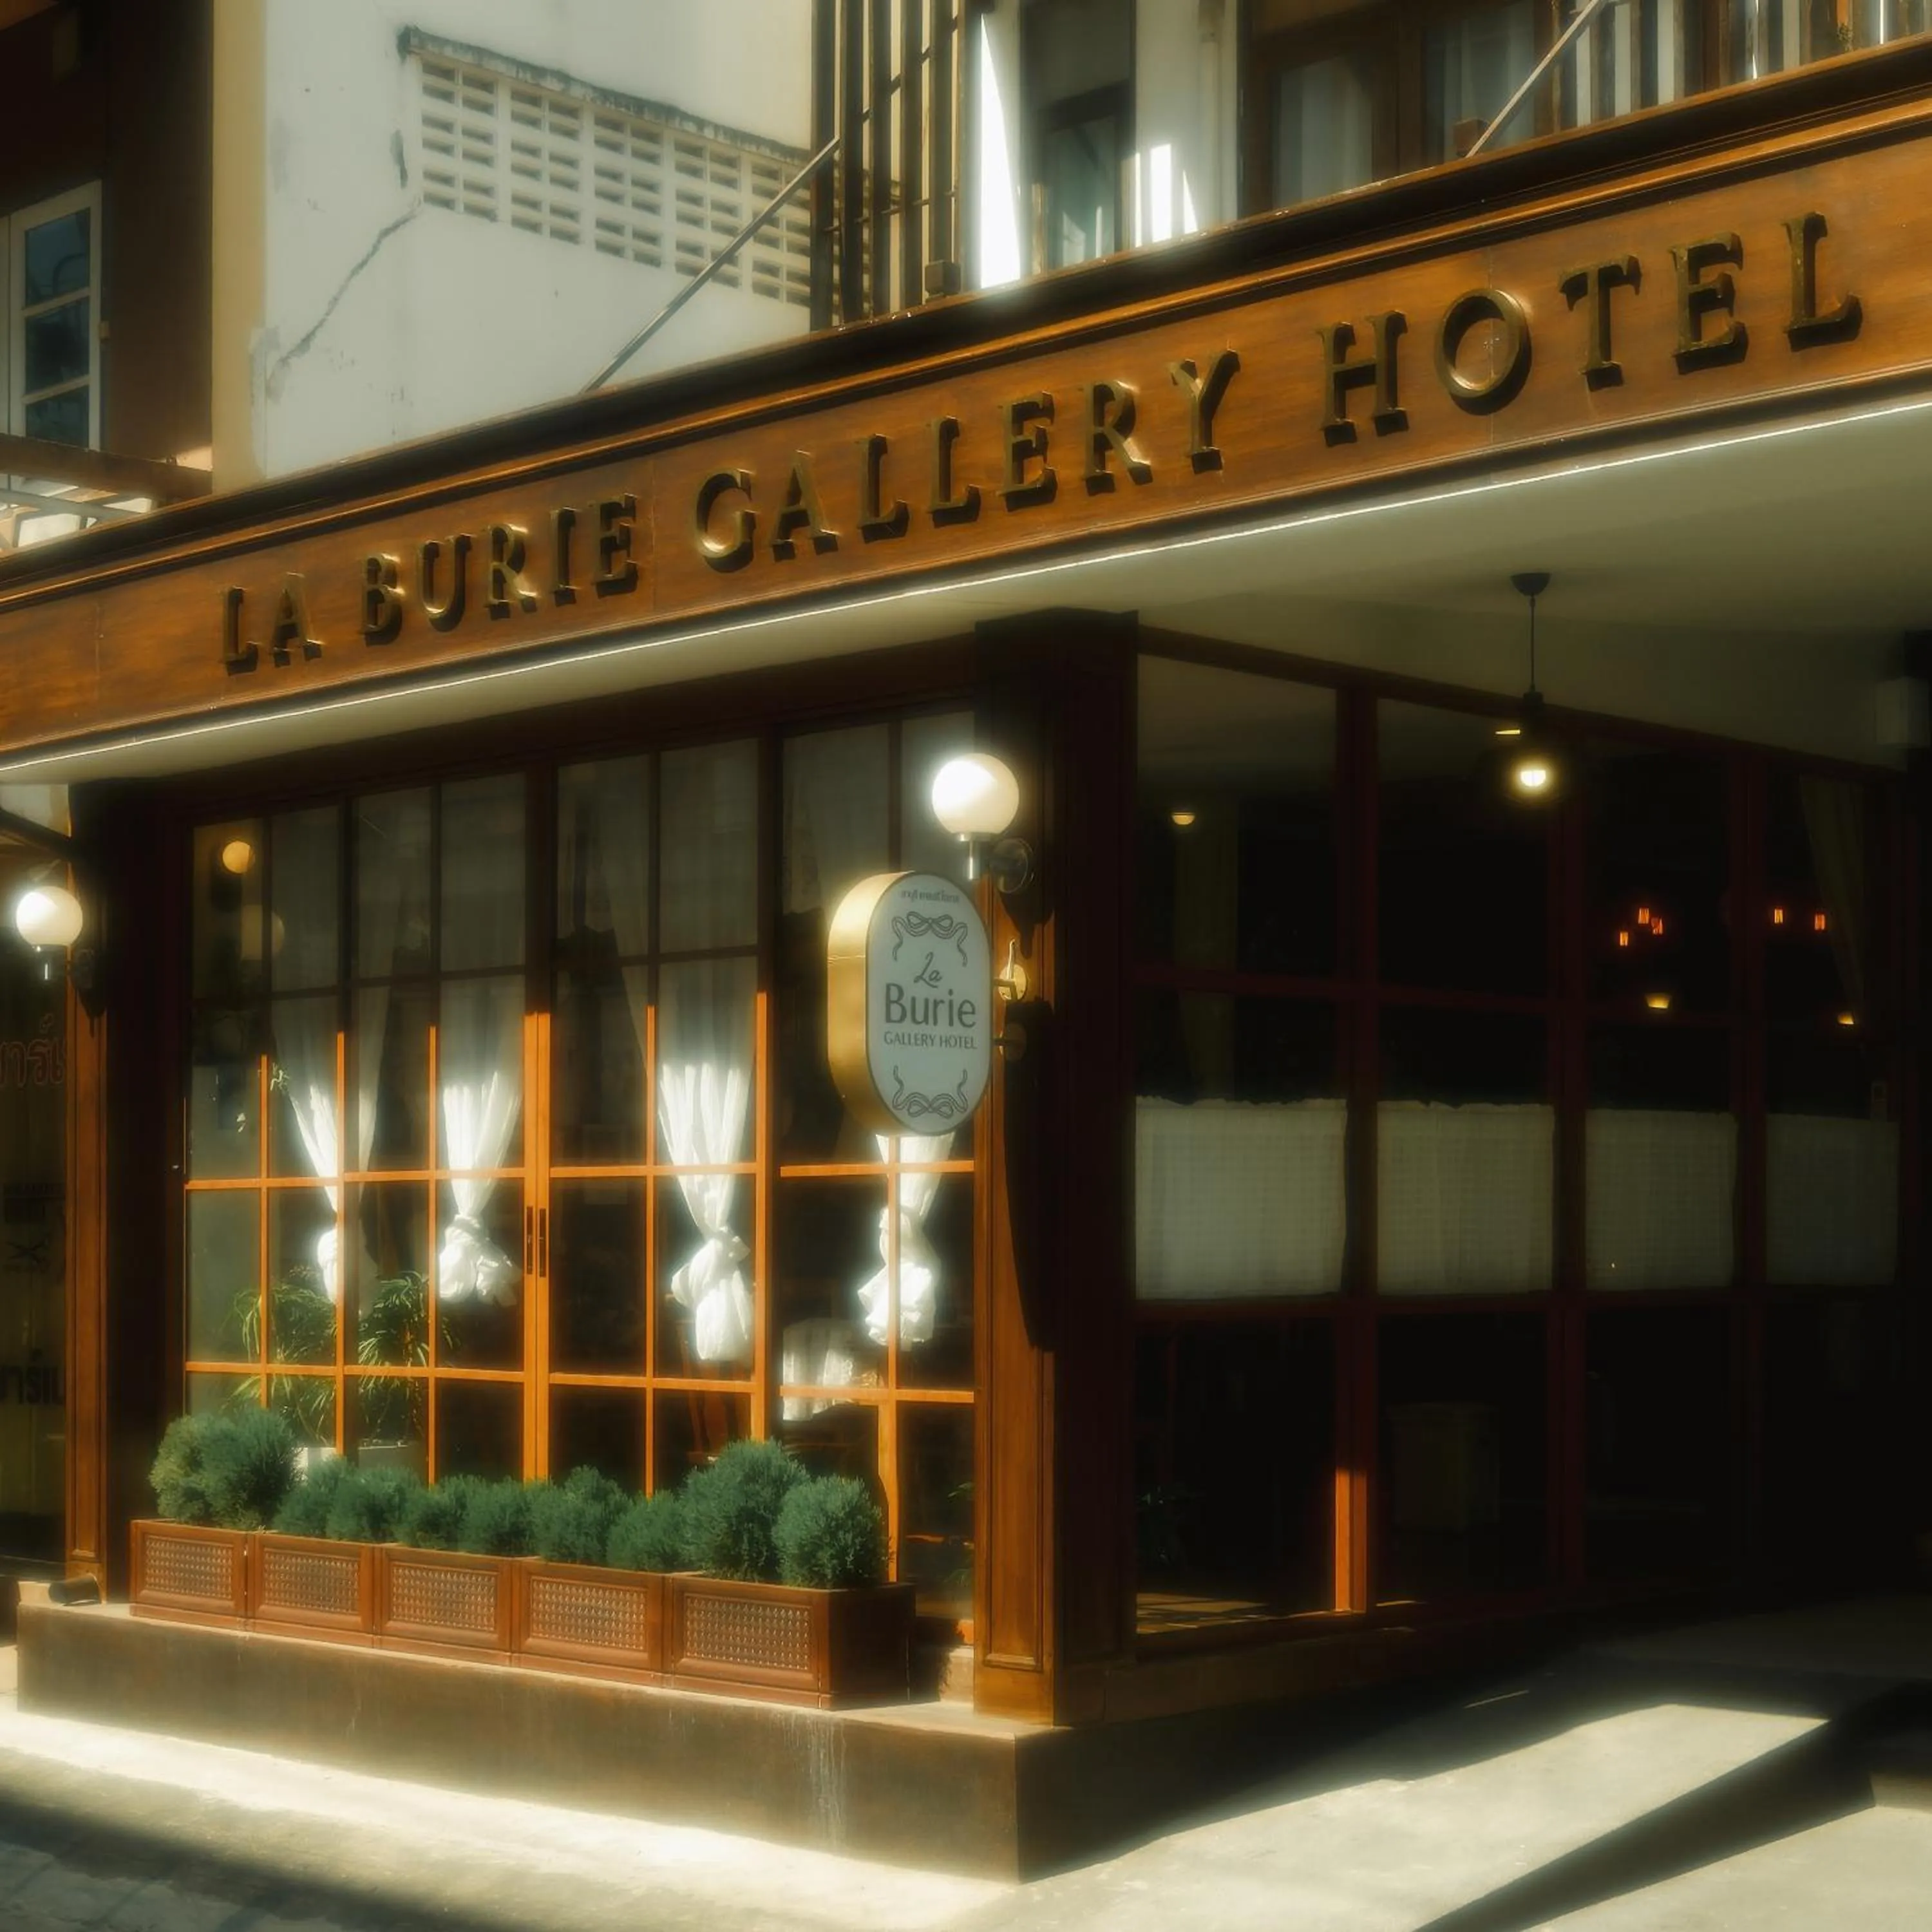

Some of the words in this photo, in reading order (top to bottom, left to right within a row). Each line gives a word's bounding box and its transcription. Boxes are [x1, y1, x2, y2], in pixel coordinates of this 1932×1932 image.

[219, 572, 324, 675] LA
[360, 493, 639, 647] BURIE
[695, 348, 1240, 572] GALLERY
[1318, 211, 1863, 446] HOTEL
[913, 952, 943, 988] La
[885, 983, 976, 1028] Burie
[884, 1031, 935, 1048] GALLERY
[939, 1034, 978, 1050] HOTEL
